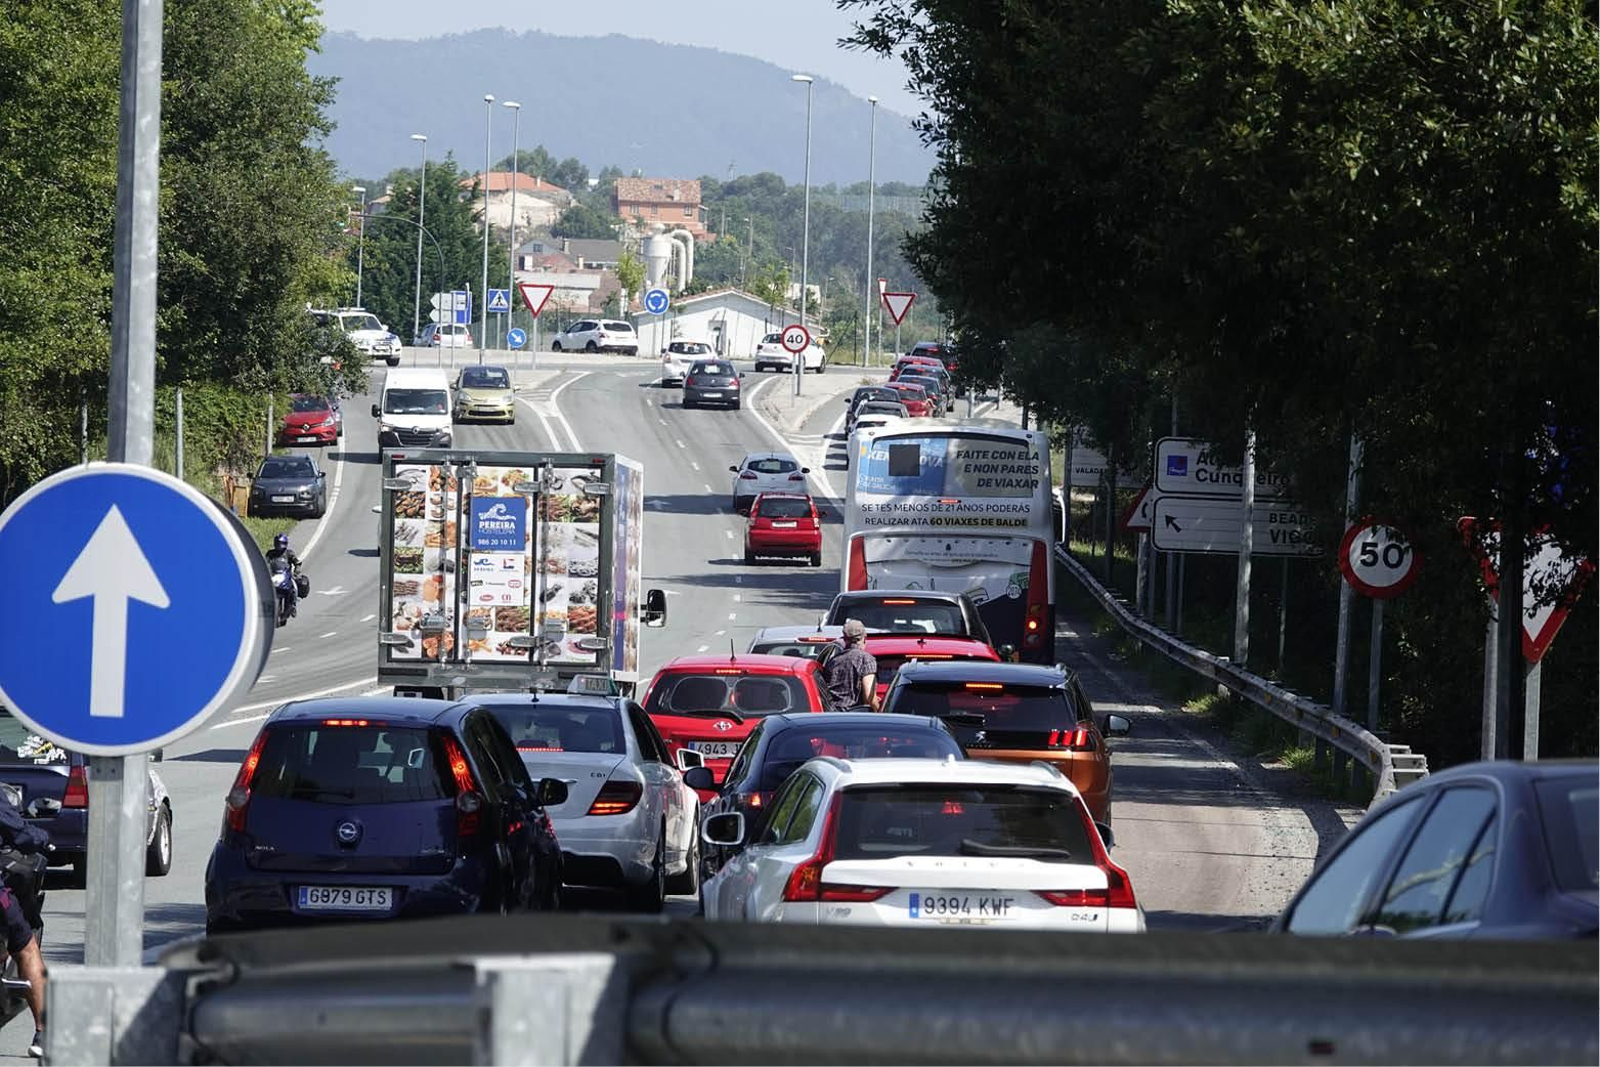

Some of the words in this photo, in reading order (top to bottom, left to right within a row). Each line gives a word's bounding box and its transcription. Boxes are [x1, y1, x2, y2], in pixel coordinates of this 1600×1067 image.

[787, 334, 804, 344] 40
[956, 450, 990, 460] FAITE
[991, 450, 1016, 460] CON
[1017, 451, 1039, 461] ELA
[964, 463, 972, 473] E
[972, 463, 999, 474] NON
[1000, 464, 1039, 475] PARES
[977, 478, 994, 488] DE
[994, 479, 1039, 489] VIAXAR
[1195, 468, 1291, 488] Cunqeiro
[861, 503, 873, 512] SE
[875, 503, 892, 512] TES
[894, 503, 930, 512] MENOS
[931, 503, 944, 512] DE
[945, 504, 955, 512] 21
[956, 503, 984, 513] ANOS
[986, 503, 1031, 514] PODERÁS
[479, 520, 516, 529] PEREIRA
[865, 517, 910, 526] REALIZAR
[911, 517, 930, 526] ATA
[930, 517, 943, 526] 60
[944, 517, 979, 526] VIAXES
[980, 518, 995, 527] DE
[996, 518, 1028, 527] BALDE
[478, 538, 490, 546] 986
[490, 538, 499, 546] 20
[500, 538, 508, 546] 10
[509, 538, 517, 546] 11
[1360, 542, 1404, 569] 50
[586, 678, 608, 691] TAXI
[697, 743, 727, 755] 4943
[309, 888, 352, 905] 6979
[355, 889, 387, 906] GTS
[923, 896, 971, 915] 9394
[979, 897, 1015, 916] KWF
